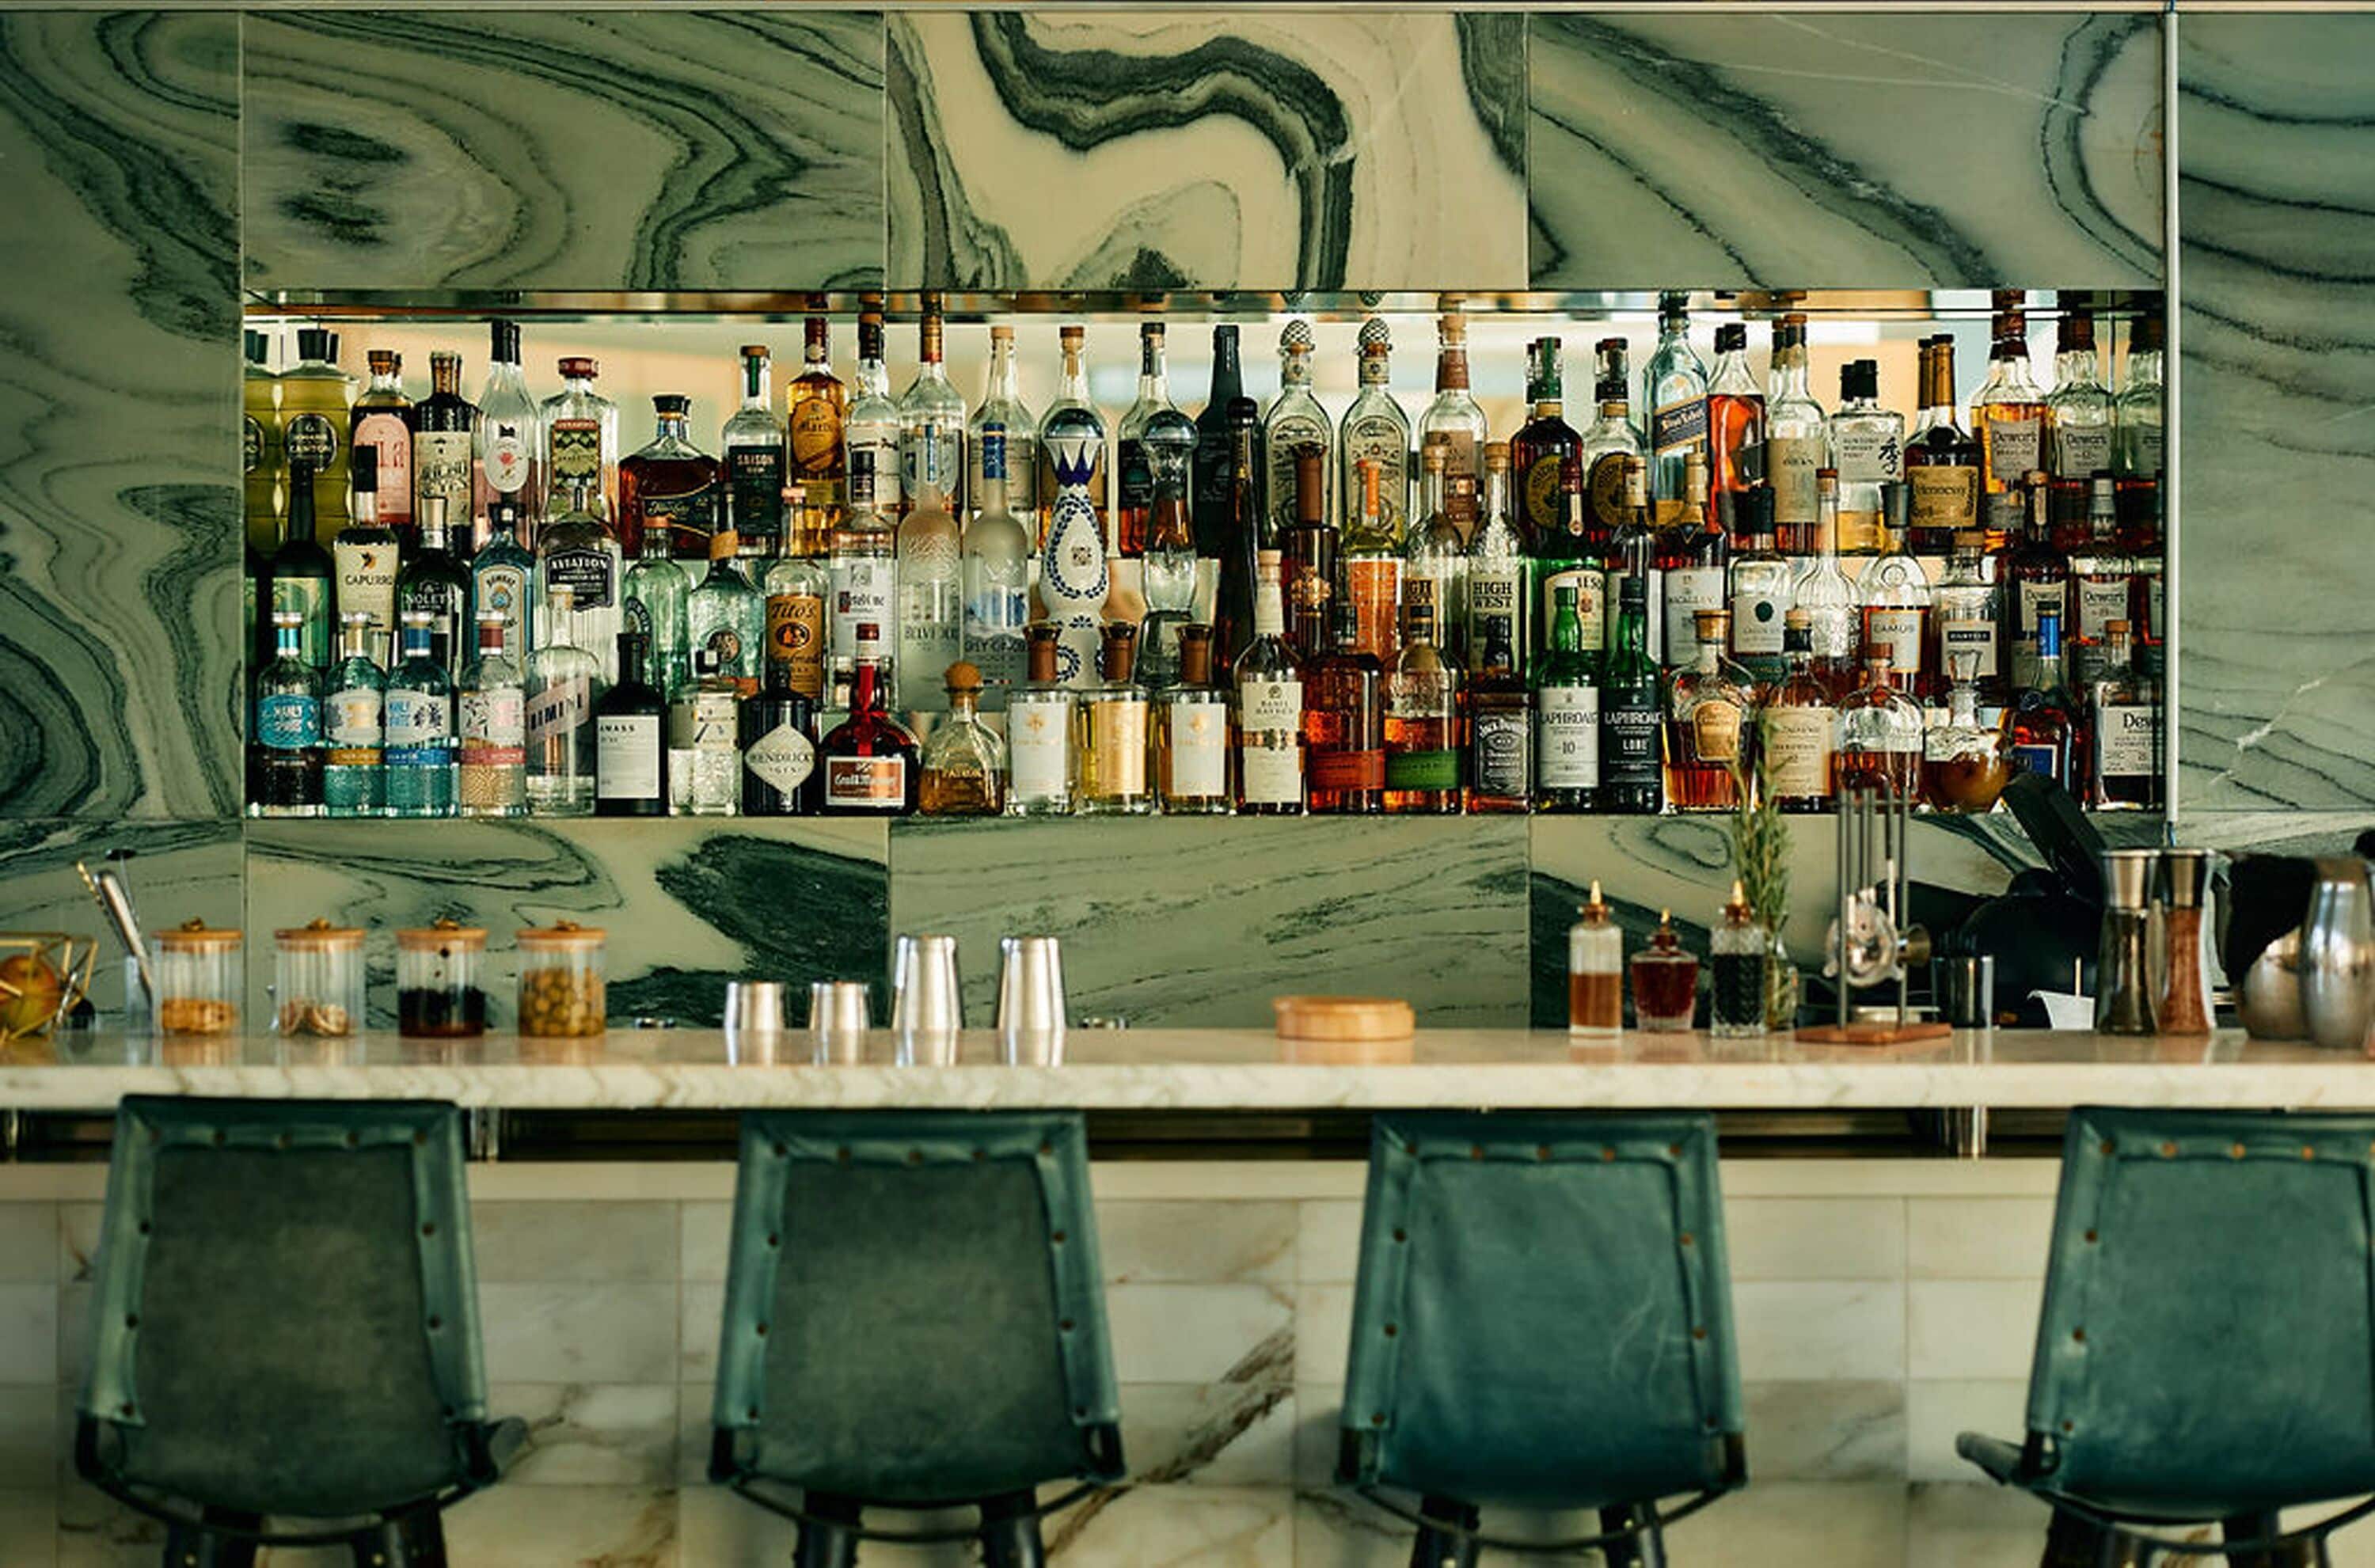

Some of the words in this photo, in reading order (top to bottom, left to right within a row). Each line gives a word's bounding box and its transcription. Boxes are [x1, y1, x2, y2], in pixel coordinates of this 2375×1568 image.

[736, 454, 777, 465] SAISON
[551, 557, 606, 570] AVIATION
[345, 575, 393, 586] CAPURRO
[1472, 581, 1512, 595] HIGH
[1472, 595, 1513, 608] WEST
[772, 601, 819, 619] Tito's
[1562, 741, 1576, 753] 10
